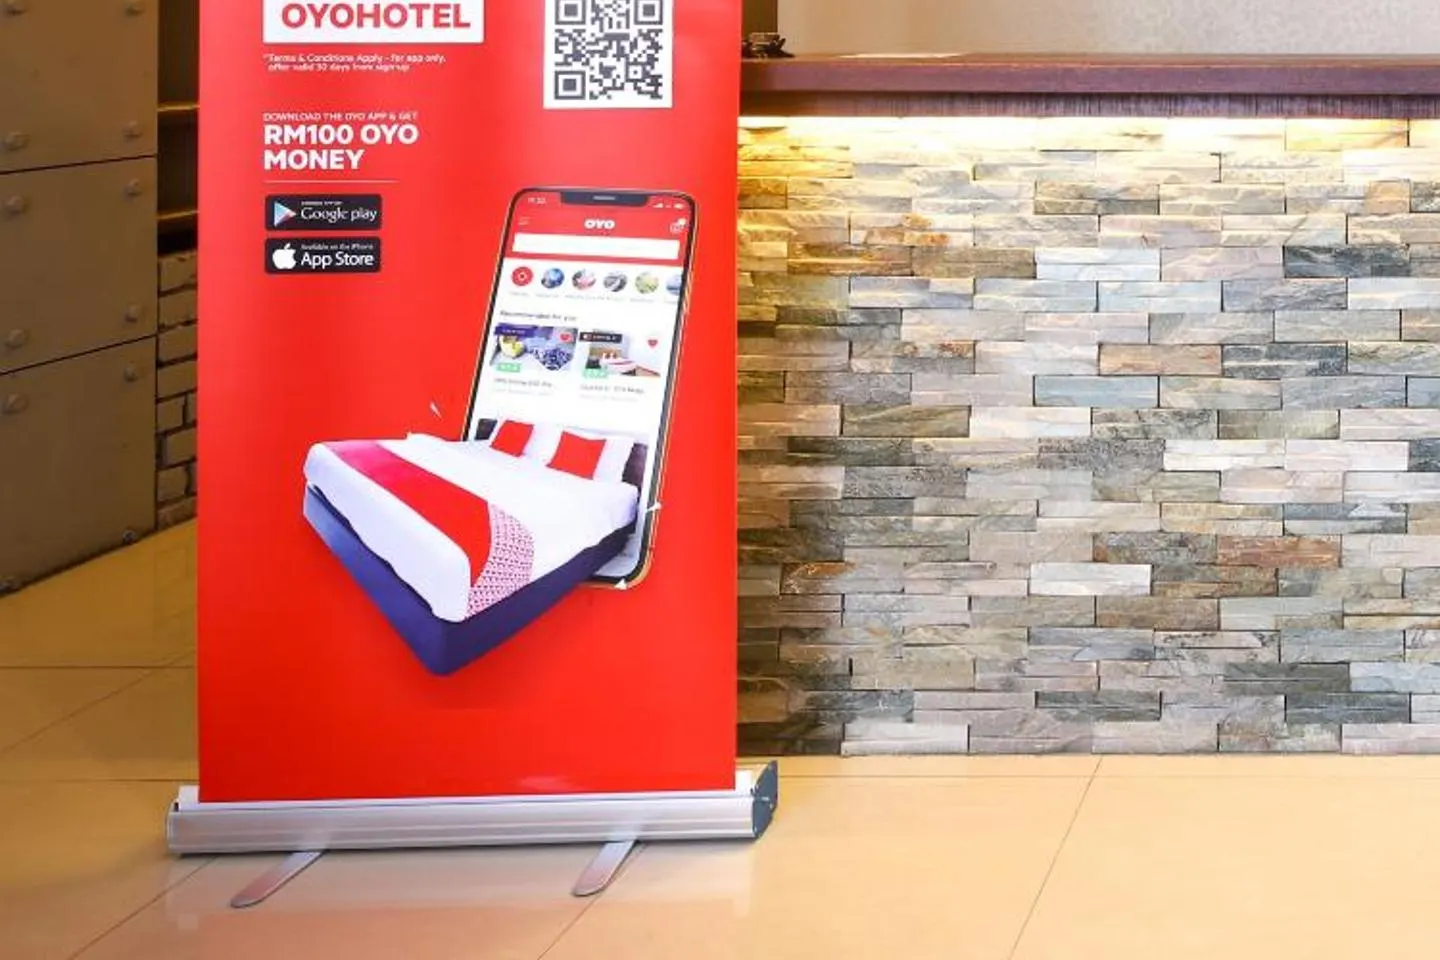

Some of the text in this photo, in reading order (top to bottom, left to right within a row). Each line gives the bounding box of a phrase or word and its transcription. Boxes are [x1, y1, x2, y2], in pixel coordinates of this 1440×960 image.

[280, 2, 471, 30] OYOHOTEL
[356, 53, 383, 64] Apply
[263, 112, 321, 122] DOWNLOAD
[323, 112, 341, 122] THE
[344, 112, 366, 122] OYO
[367, 112, 387, 122] APP
[398, 112, 418, 122] GET
[263, 124, 419, 145] RM100 OYO
[263, 149, 365, 170] MONEY
[301, 207, 377, 223] Google play
[584, 218, 615, 230] OYO
[300, 251, 375, 270] App Store
